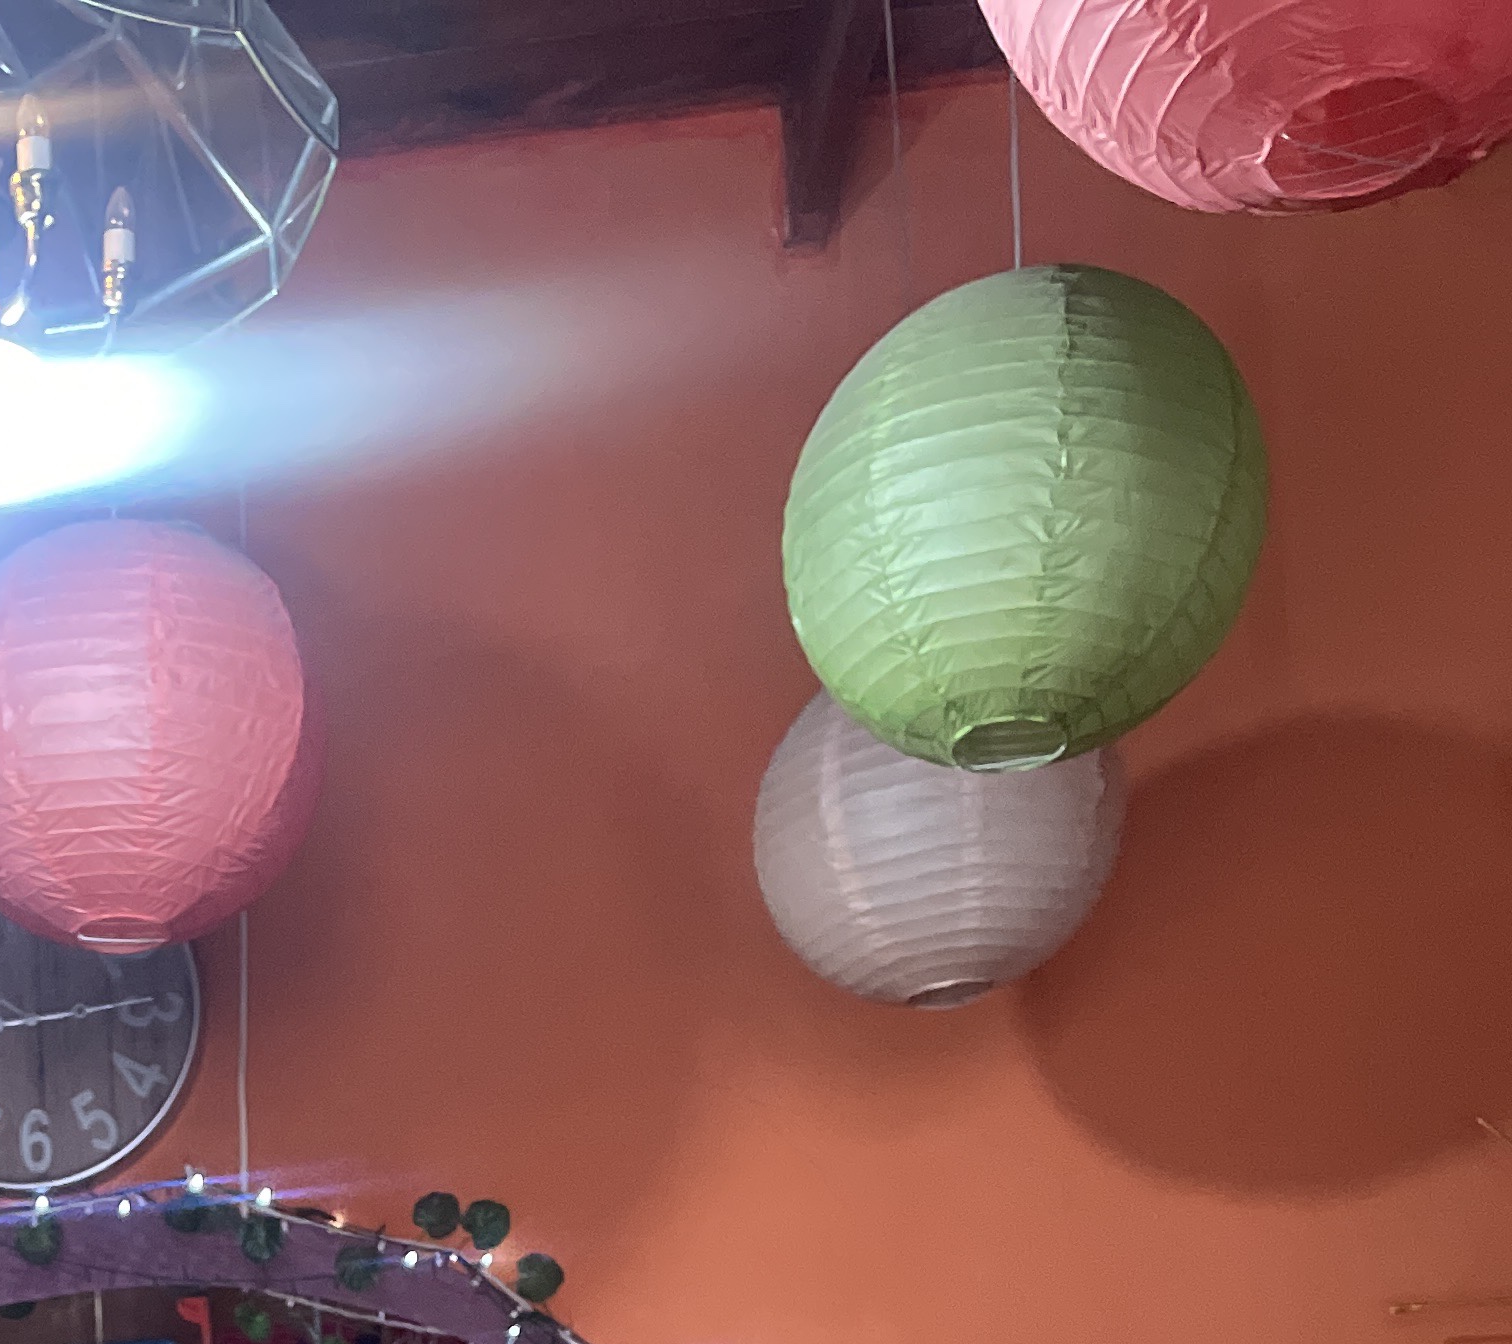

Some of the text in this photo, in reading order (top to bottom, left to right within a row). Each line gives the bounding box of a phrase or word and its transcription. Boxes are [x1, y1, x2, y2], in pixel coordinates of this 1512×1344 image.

[117, 992, 185, 1028] 3
[111, 1050, 169, 1098] 4
[19, 1108, 53, 1174] 6
[69, 1088, 120, 1151] 5
